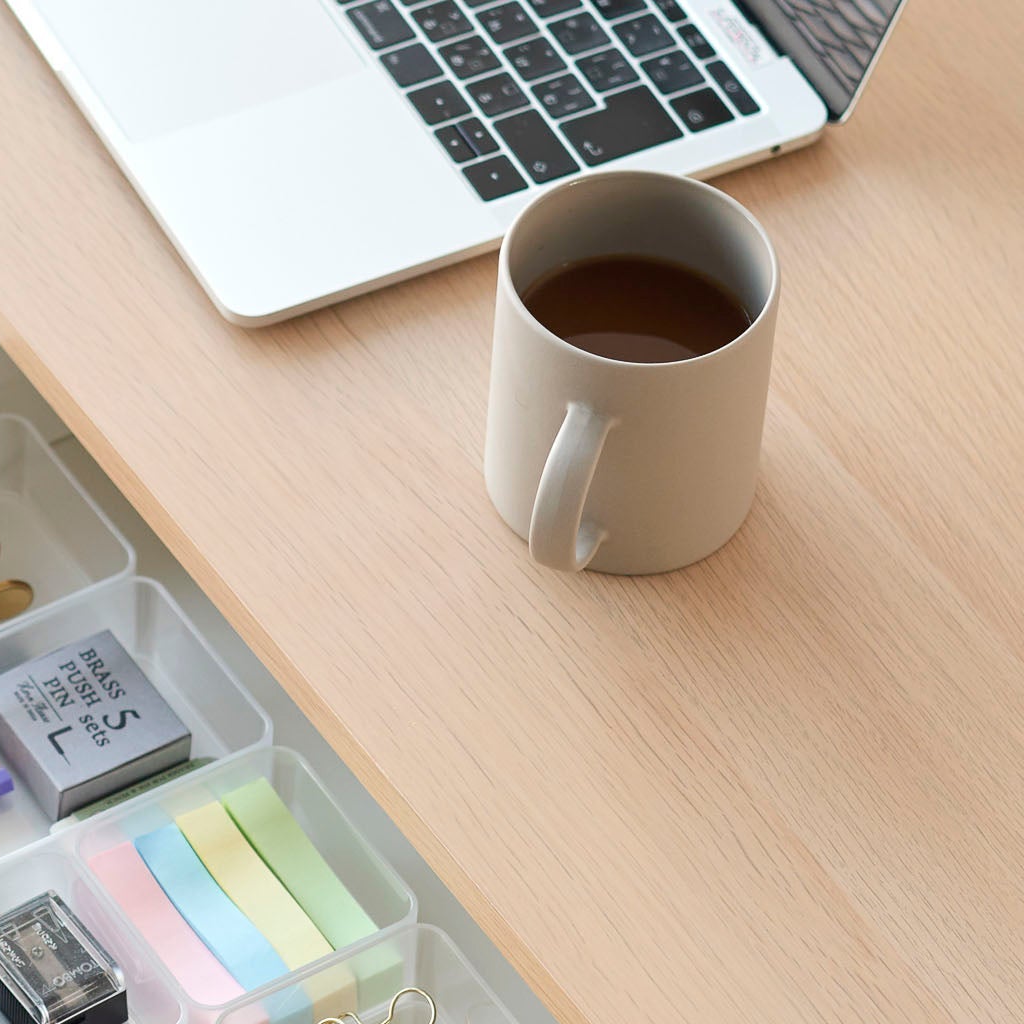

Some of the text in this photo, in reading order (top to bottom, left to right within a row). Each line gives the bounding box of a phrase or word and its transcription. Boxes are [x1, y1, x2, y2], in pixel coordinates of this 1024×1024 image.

[42, 676, 75, 709] PIN
[59, 660, 101, 708] PUSH
[78, 648, 126, 700] BRASS
[78, 714, 111, 748] sets
